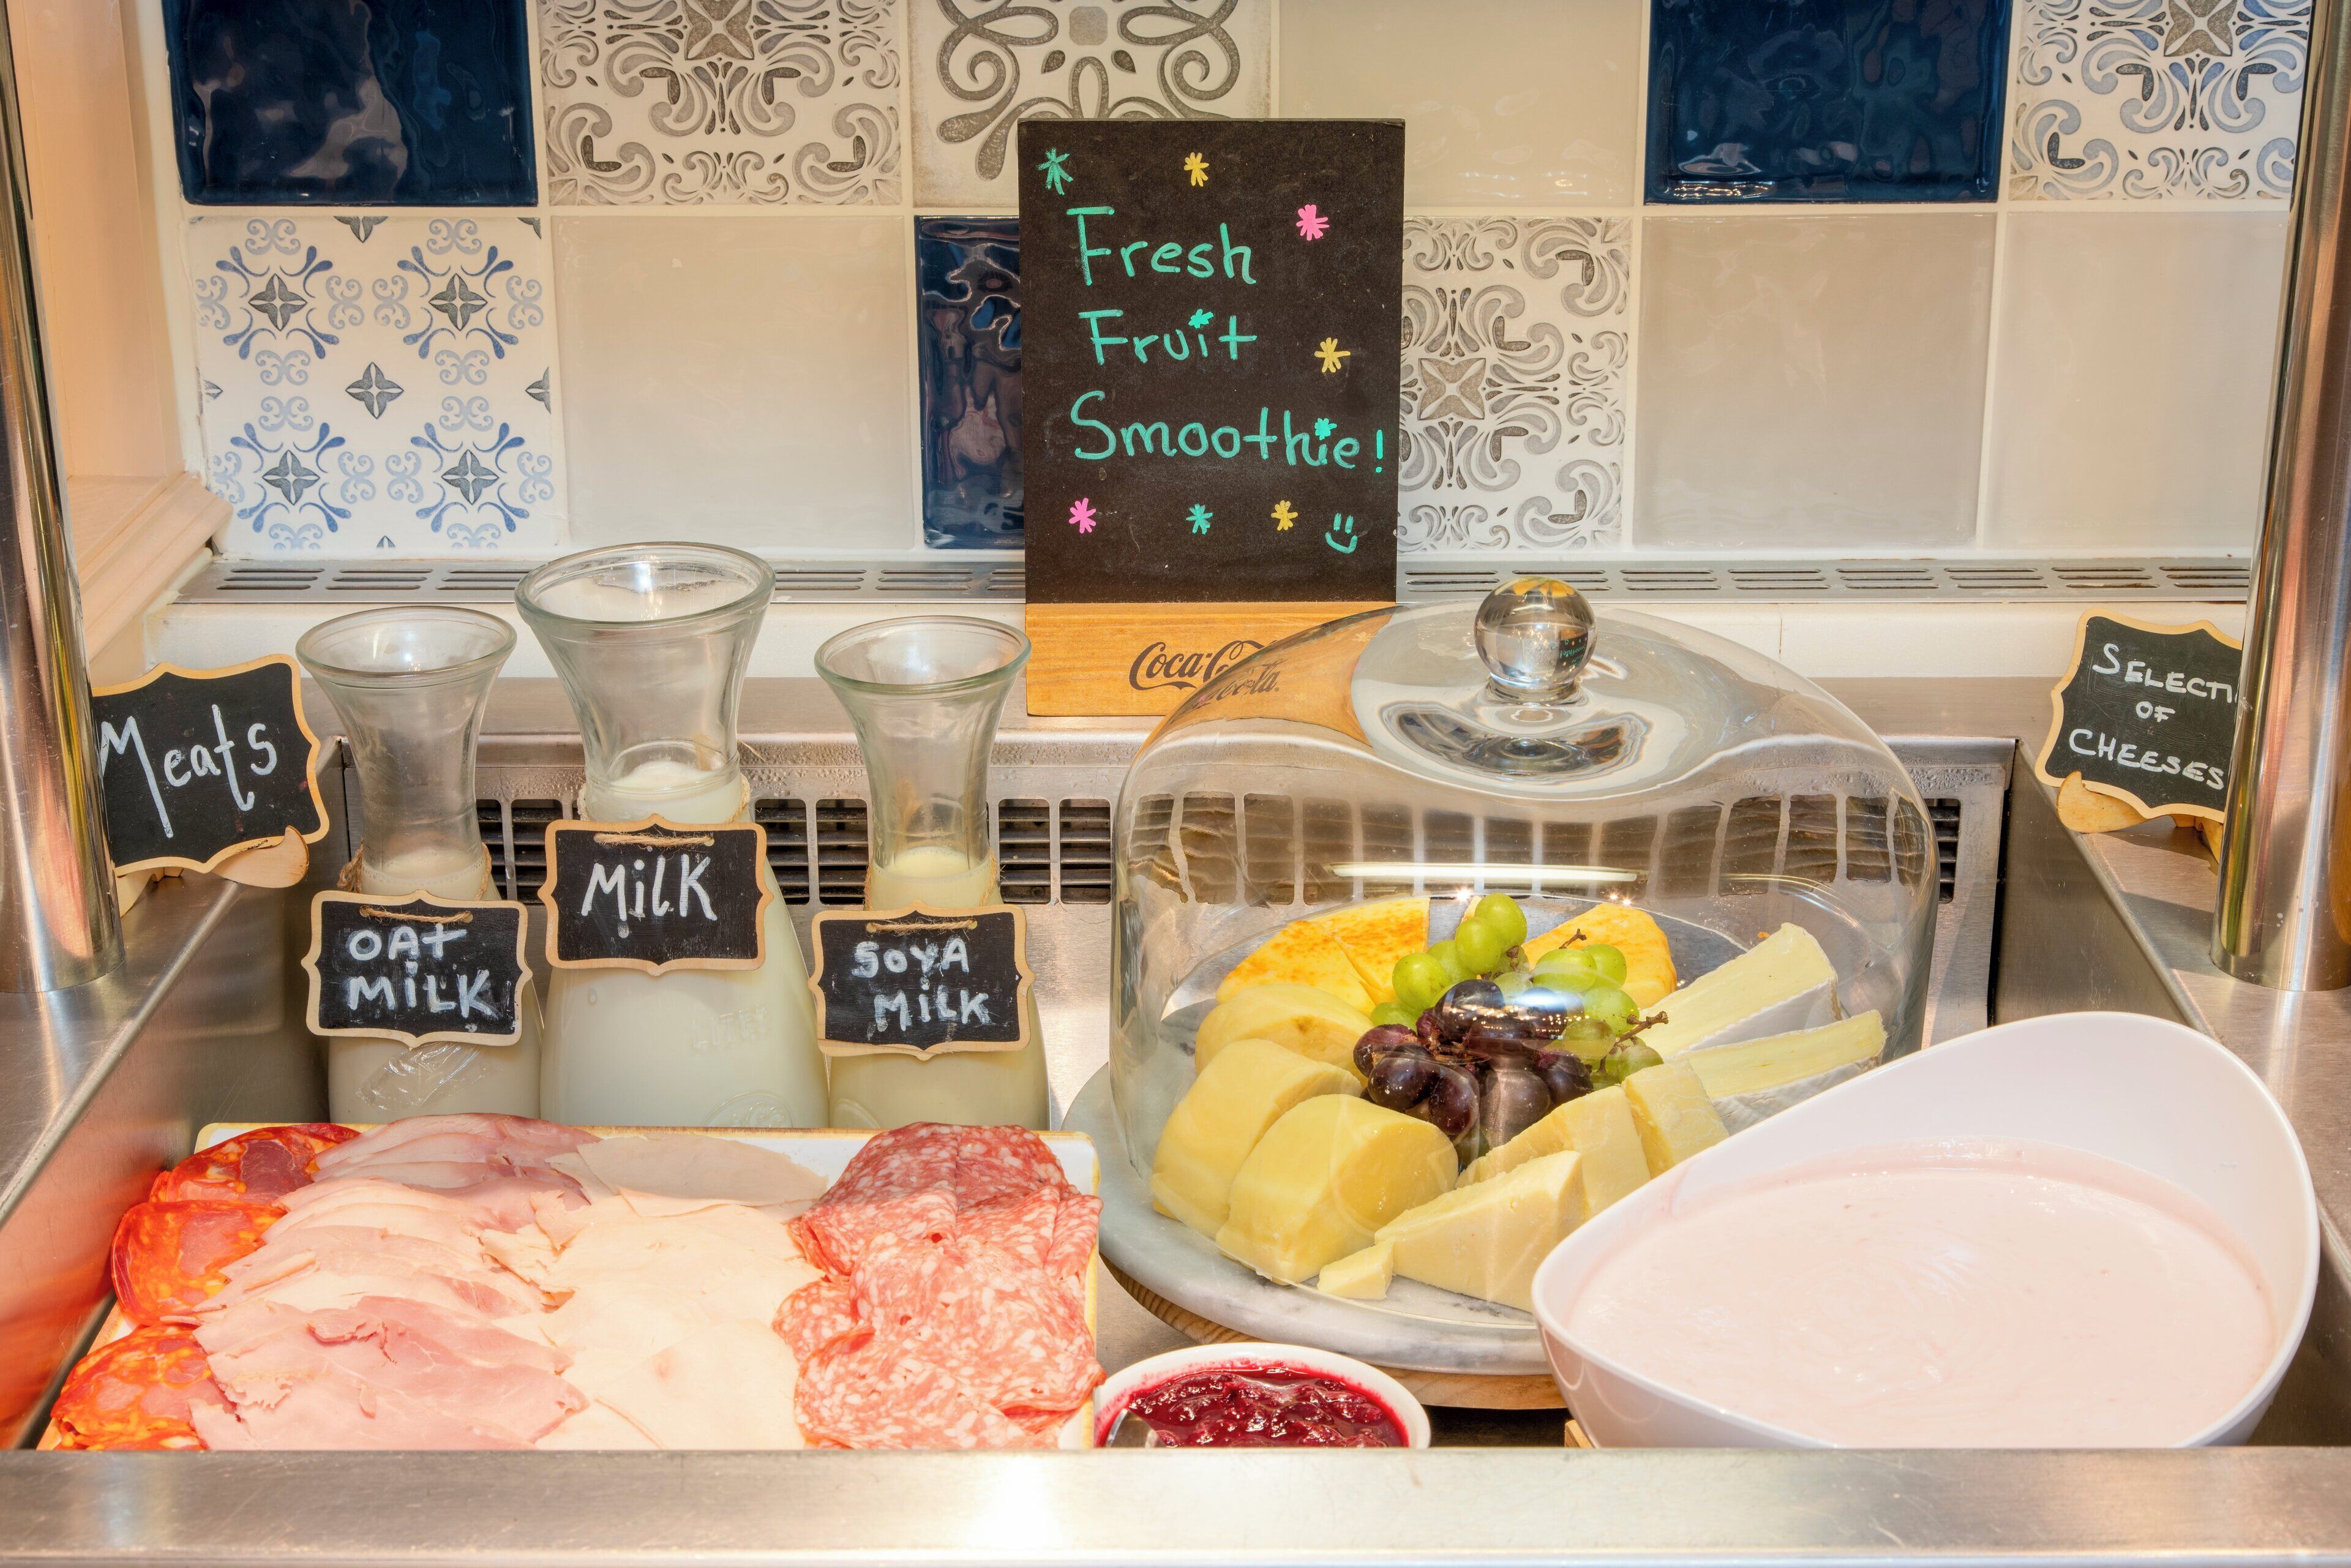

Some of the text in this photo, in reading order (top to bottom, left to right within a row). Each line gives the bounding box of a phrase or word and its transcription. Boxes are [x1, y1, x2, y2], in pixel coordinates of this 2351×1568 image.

[1067, 206, 1256, 285] Fresh
[1078, 309, 1258, 366] Fruit
[1070, 390, 1384, 473] Smoothie!
[2092, 643, 2238, 704] SELECTI
[2135, 701, 2176, 722] OF
[101, 704, 277, 838] Meats
[2069, 729, 2225, 790] CHEESES
[852, 935, 969, 978] SOYA
